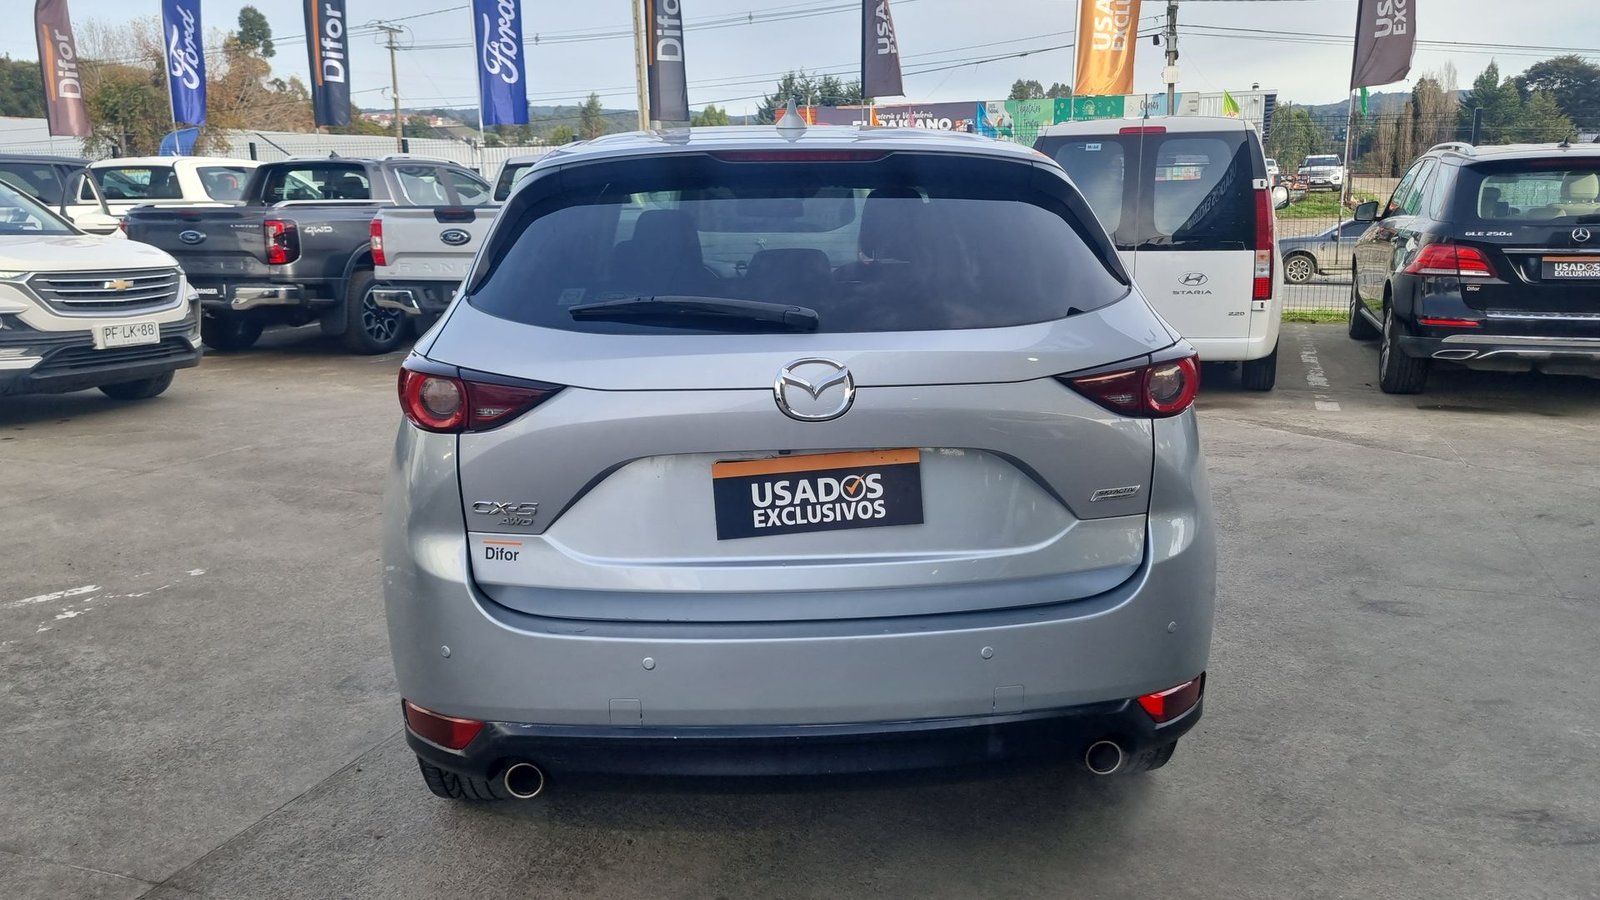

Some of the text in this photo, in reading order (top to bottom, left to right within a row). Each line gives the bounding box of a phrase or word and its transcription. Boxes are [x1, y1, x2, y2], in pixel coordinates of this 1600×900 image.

[169, 5, 200, 90] Ford
[322, 3, 345, 83] Difor
[54, 29, 81, 99] Difor
[304, 224, 333, 236] 4WD
[1554, 262, 1600, 272] USADOS
[751, 472, 885, 508] USADOS
[473, 500, 539, 517] CX-5
[753, 500, 887, 528] EXCLUSIVOS
[498, 517, 534, 526] AWD
[485, 546, 520, 561] Difor
